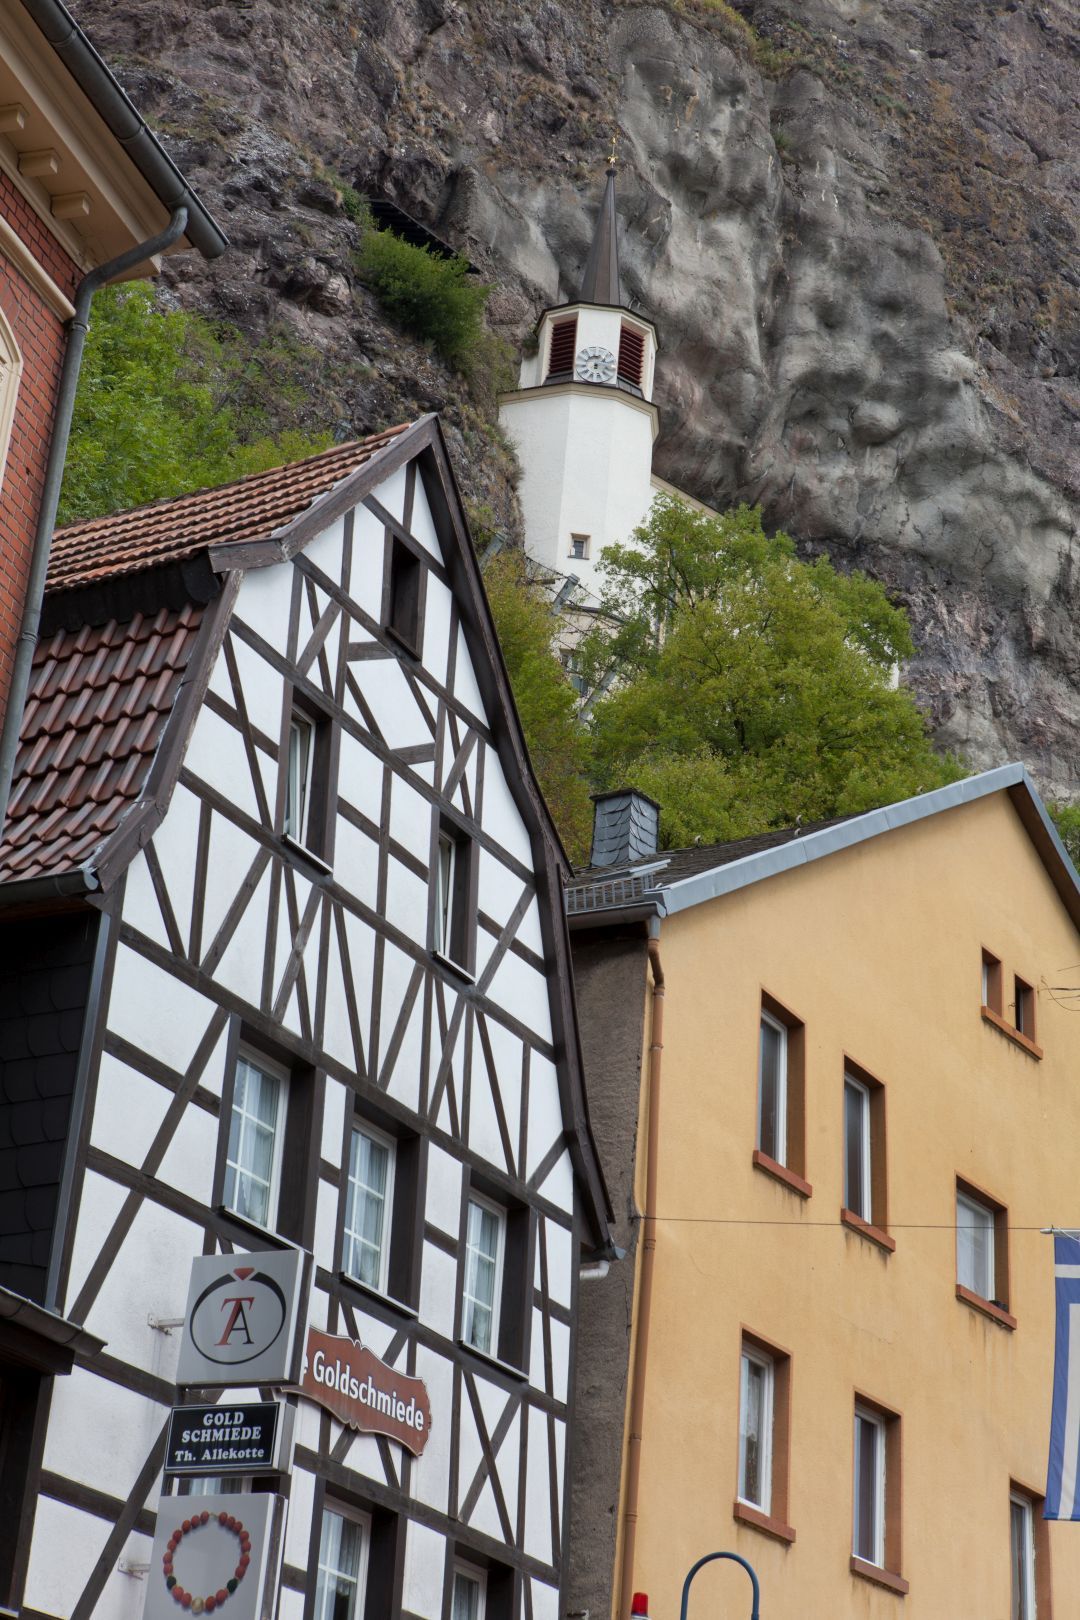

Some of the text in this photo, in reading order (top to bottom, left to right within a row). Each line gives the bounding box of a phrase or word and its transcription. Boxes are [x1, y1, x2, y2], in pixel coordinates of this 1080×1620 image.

[313, 1350, 424, 1431] Goldschmiede
[203, 1411, 244, 1426] GOLD
[182, 1426, 262, 1443] SCHMIEDE
[175, 1447, 265, 1462] Th. Allekotte
